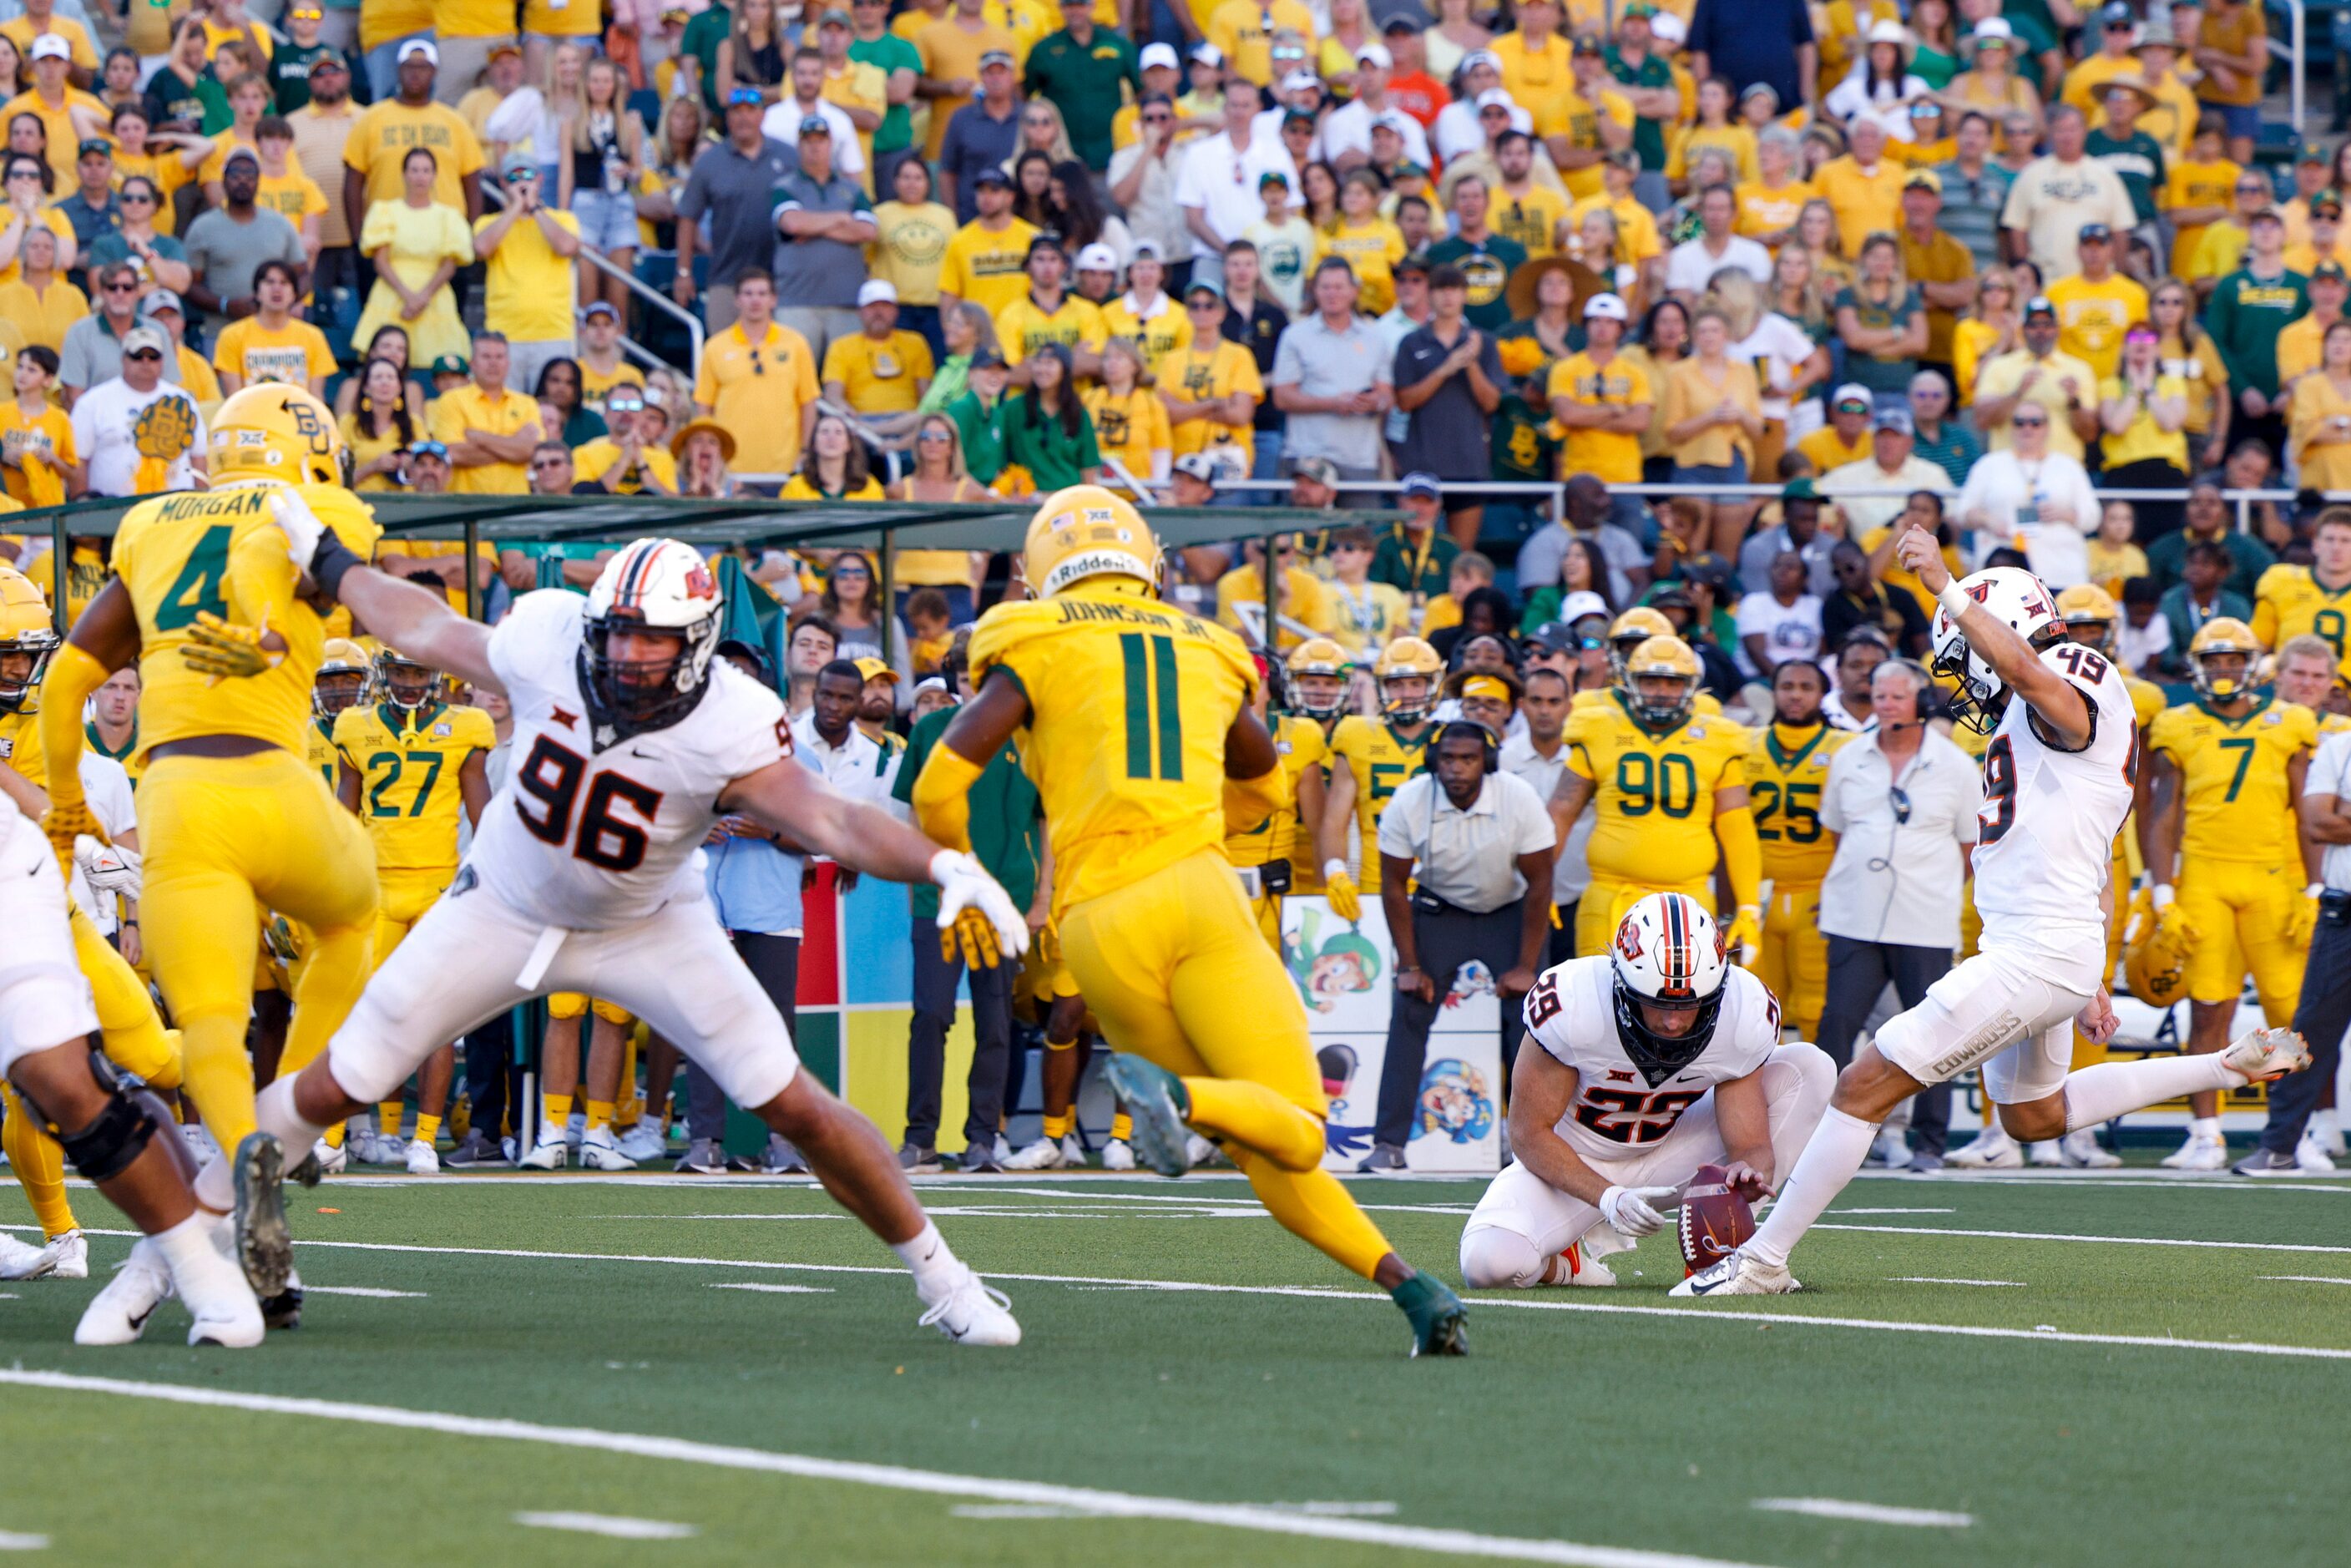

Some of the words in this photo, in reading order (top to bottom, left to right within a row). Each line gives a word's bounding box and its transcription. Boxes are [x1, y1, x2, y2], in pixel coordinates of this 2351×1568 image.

[154, 490, 268, 524] MORGAN
[154, 524, 234, 633] 4
[1058, 600, 1172, 631] JOHNSON
[2056, 647, 2108, 686] 49
[1119, 632, 1183, 782] 11
[367, 751, 444, 817] 27
[1616, 751, 1697, 819] 90
[2219, 738, 2256, 802] 7
[514, 734, 665, 873] 96
[1750, 781, 1822, 843] 25
[1527, 972, 1563, 1029] 29
[1932, 1009, 2021, 1075] COWBOYS
